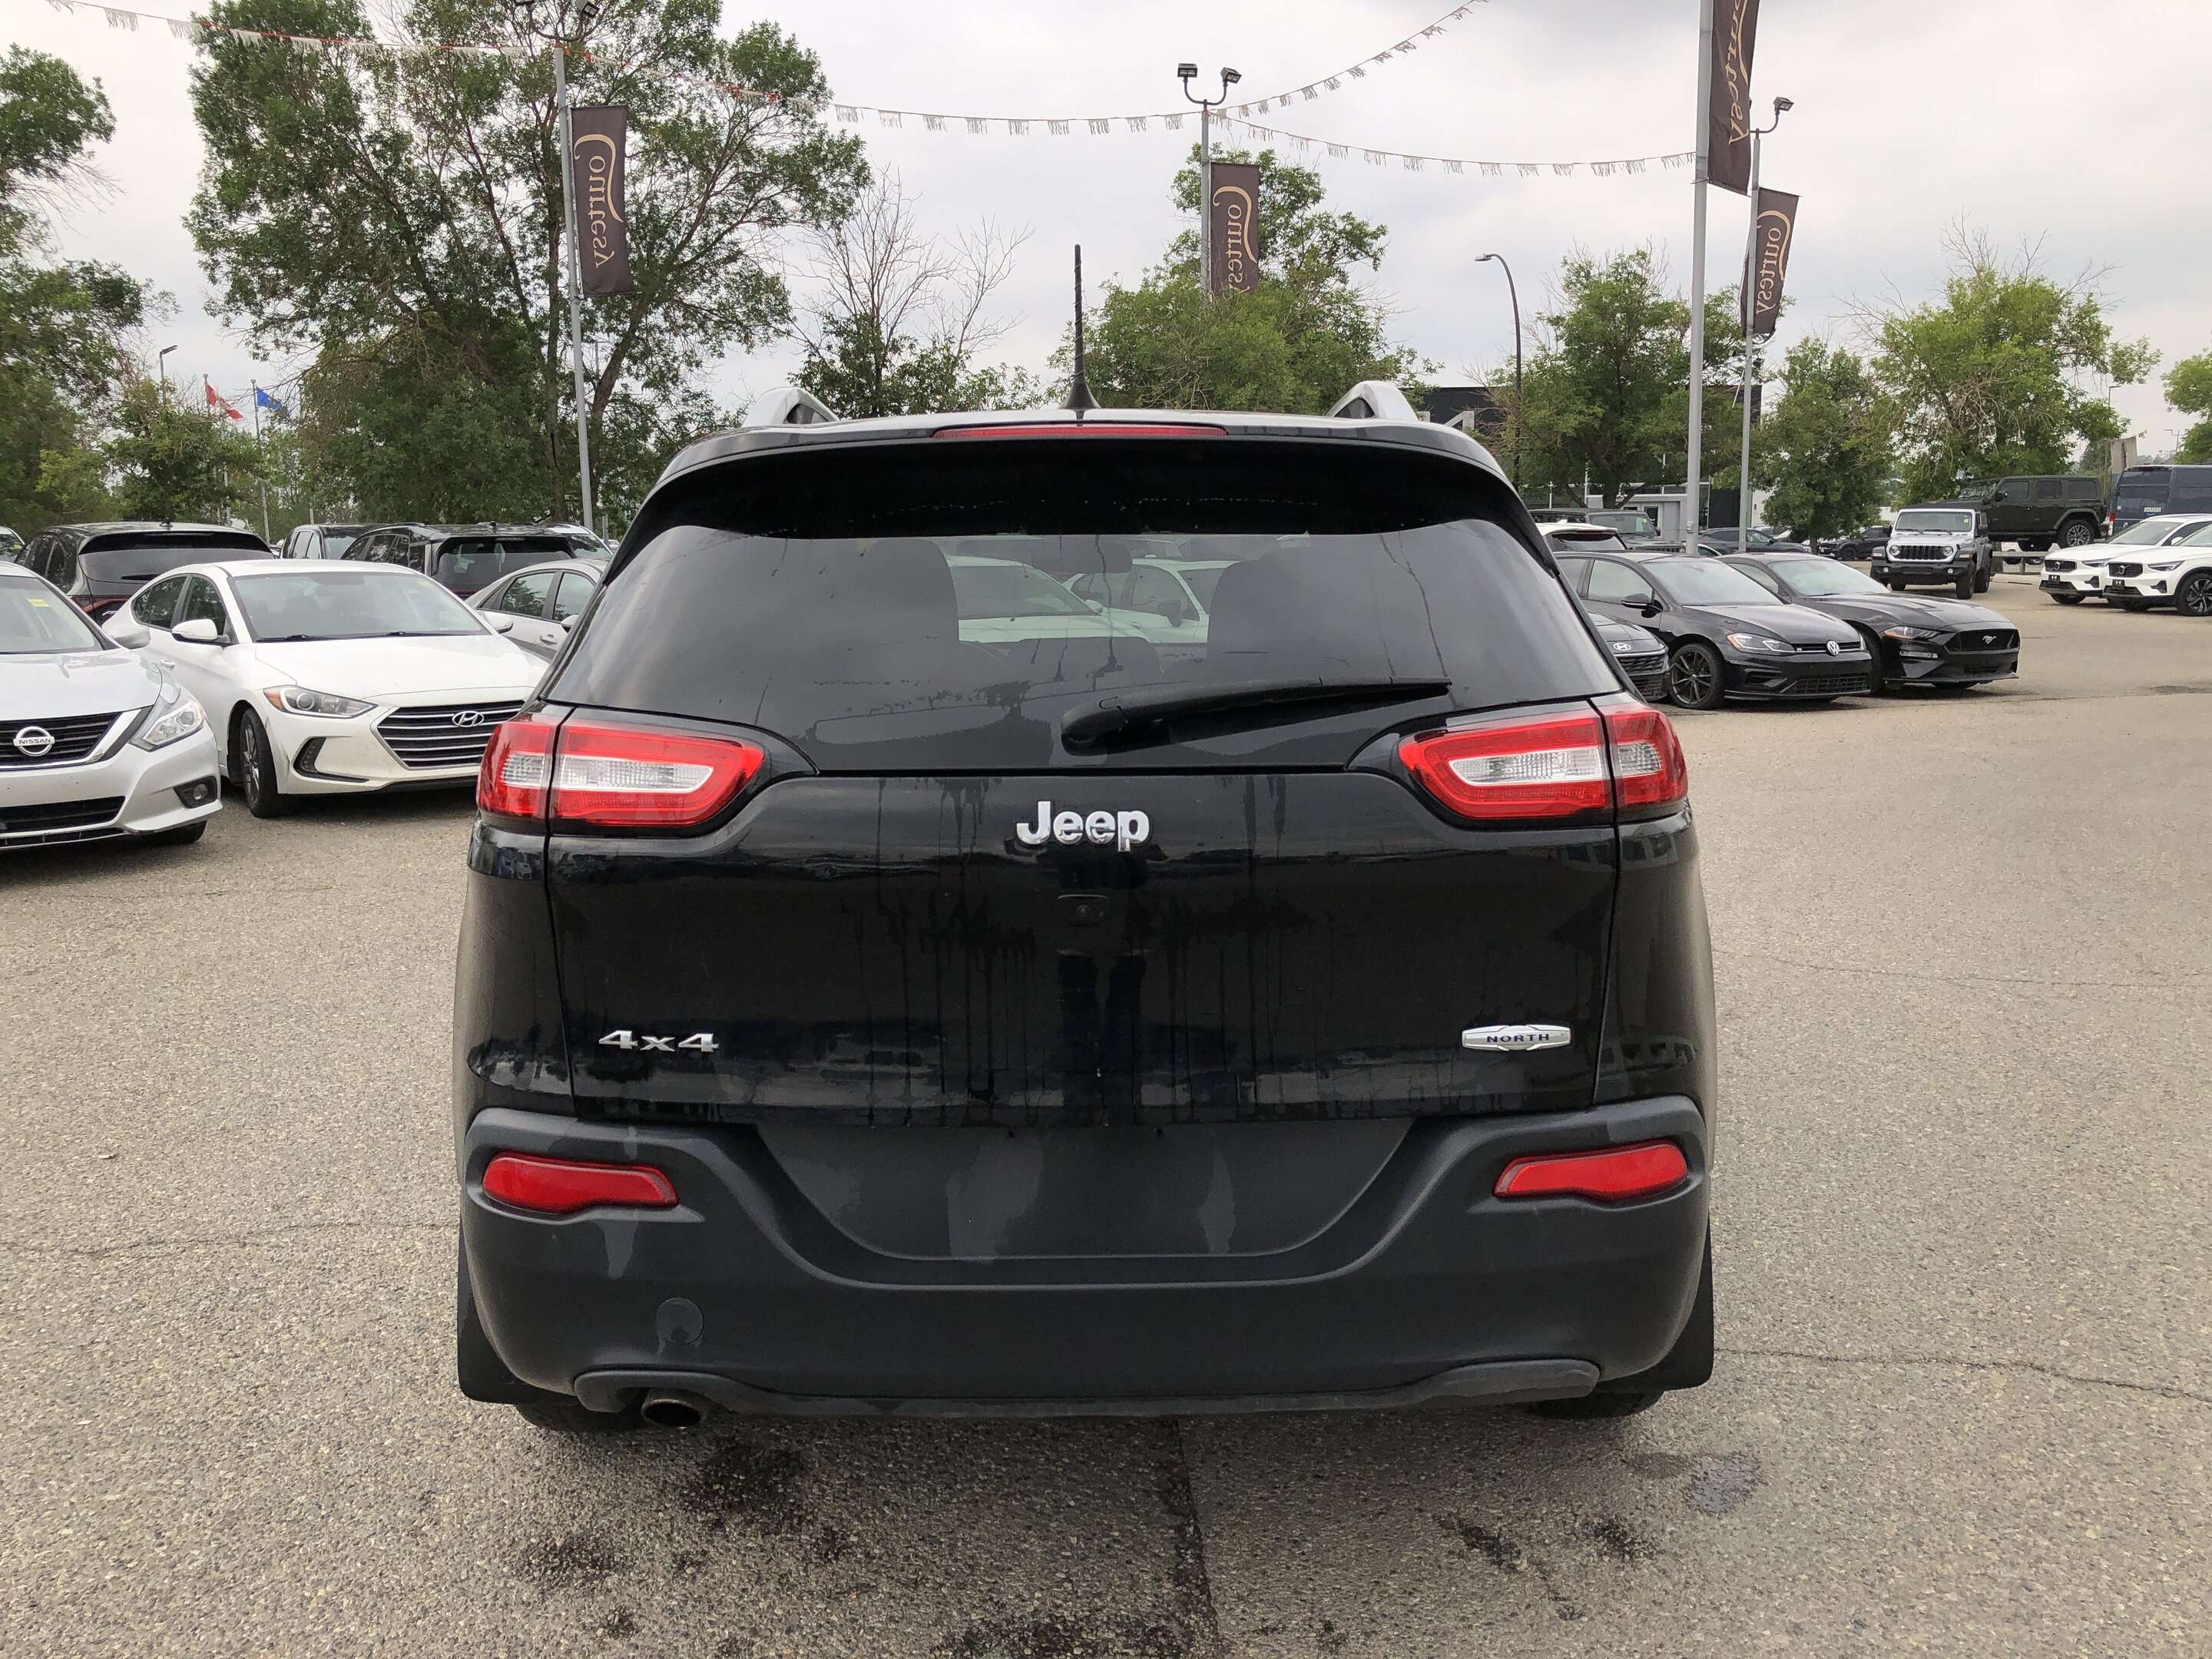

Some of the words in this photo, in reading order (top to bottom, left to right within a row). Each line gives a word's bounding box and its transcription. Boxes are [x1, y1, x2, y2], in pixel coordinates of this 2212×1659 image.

[1015, 800, 1151, 853] Jeep
[598, 1030, 720, 1053] 4x4
[1486, 1034, 1549, 1043] NORTH
